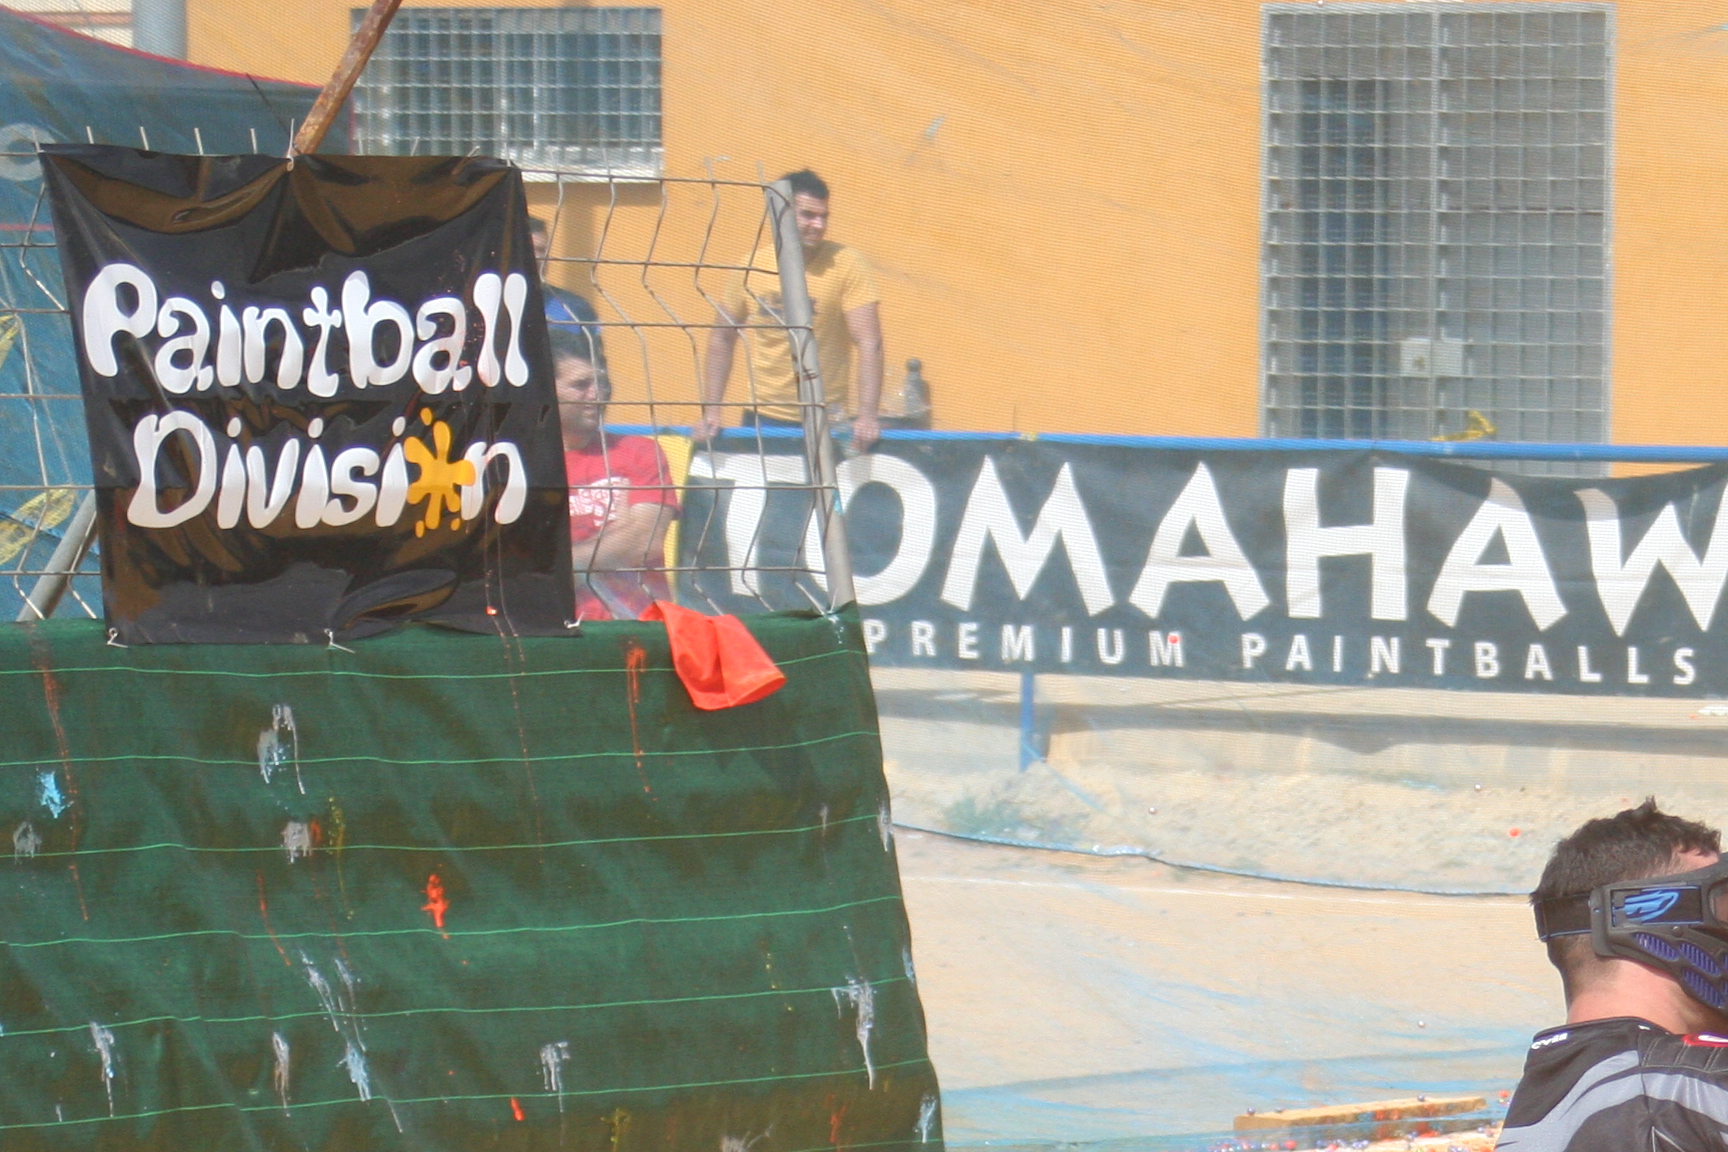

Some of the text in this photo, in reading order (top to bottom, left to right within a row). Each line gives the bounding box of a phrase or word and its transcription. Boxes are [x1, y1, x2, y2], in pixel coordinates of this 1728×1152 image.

[83, 263, 529, 397] Paintball
[863, 619, 1698, 686] PREMIUM PAINTBALLS
